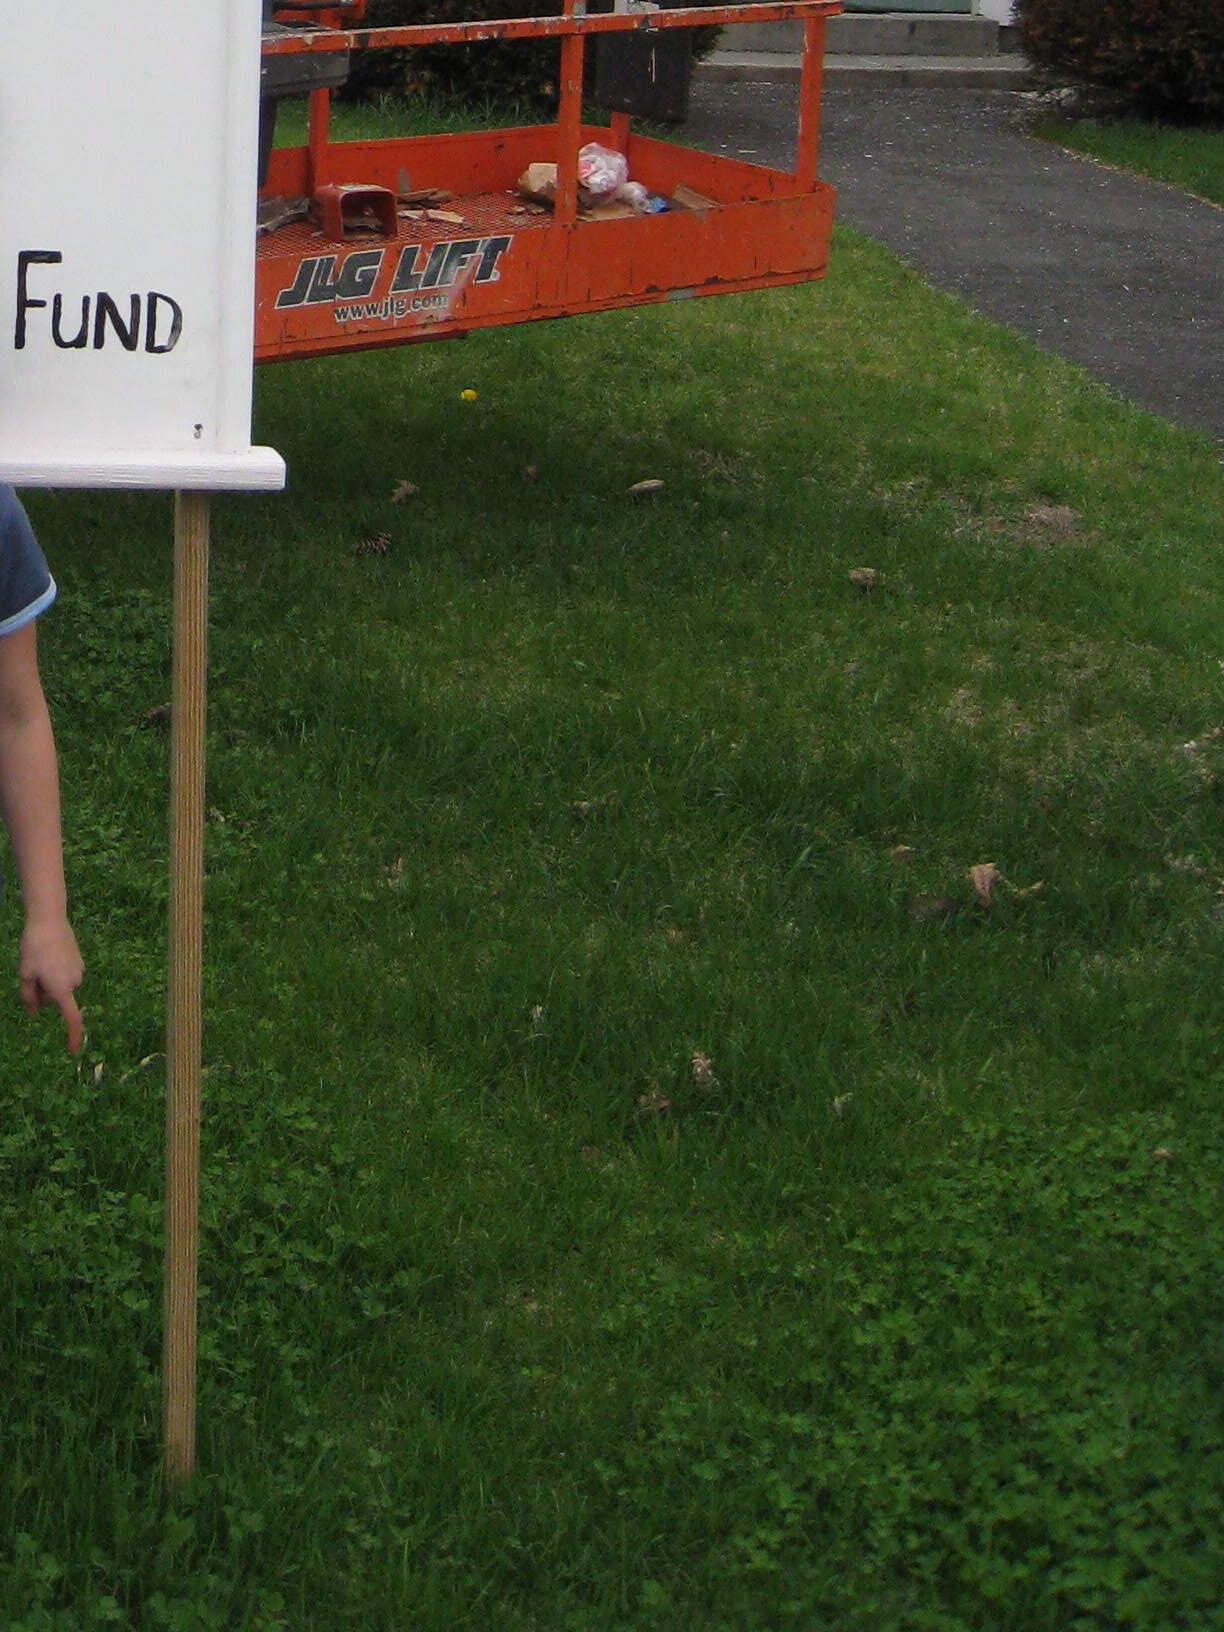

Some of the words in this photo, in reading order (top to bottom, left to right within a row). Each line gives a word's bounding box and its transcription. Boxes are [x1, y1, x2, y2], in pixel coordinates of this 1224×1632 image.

[14, 250, 184, 354] FUND
[274, 248, 385, 310] JLG
[387, 234, 514, 296] LIFT
[333, 295, 451, 323] www.jlg.com
